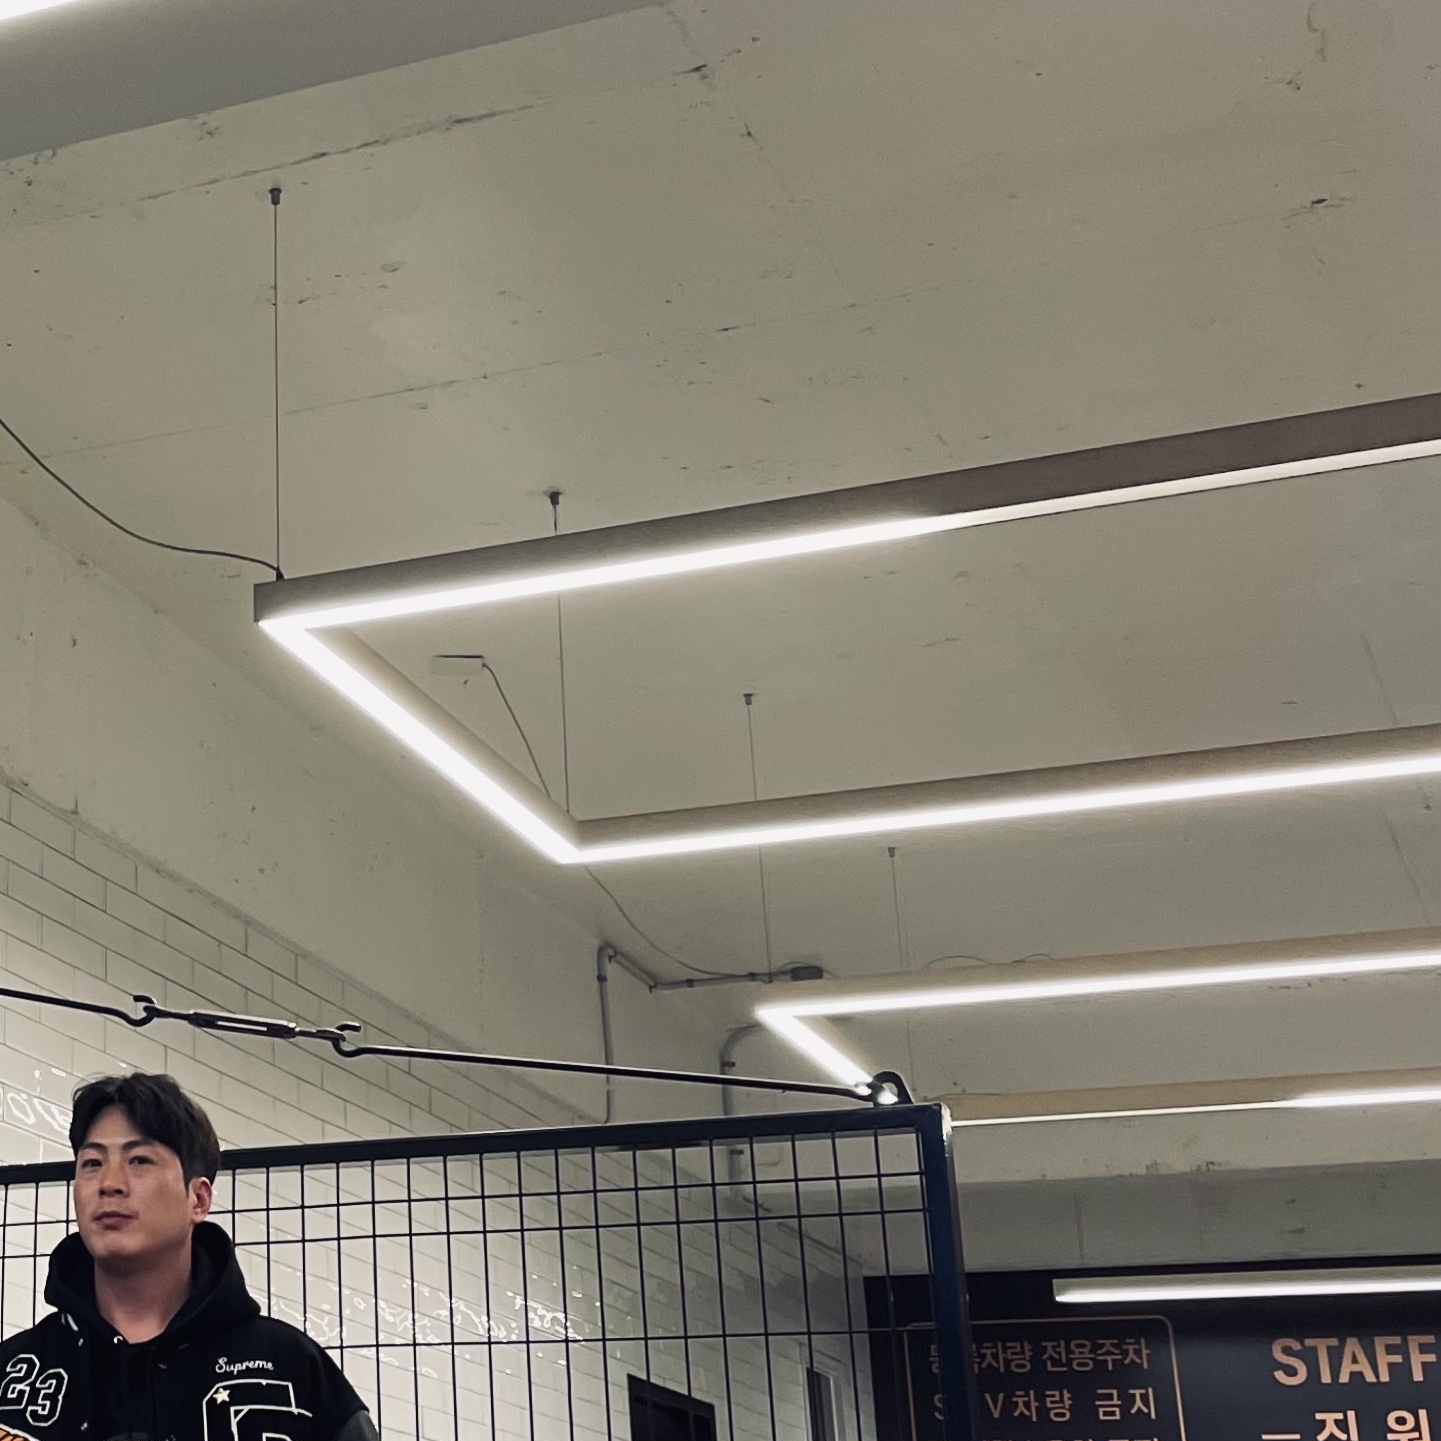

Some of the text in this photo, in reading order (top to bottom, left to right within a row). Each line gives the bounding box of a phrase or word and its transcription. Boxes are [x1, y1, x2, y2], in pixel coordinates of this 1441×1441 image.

[215, 1357, 274, 1376] Supreme
[1042, 1337, 1152, 1372] 전용주차
[1271, 1335, 1438, 1386] STAFF
[1095, 1387, 1158, 1421] 금지
